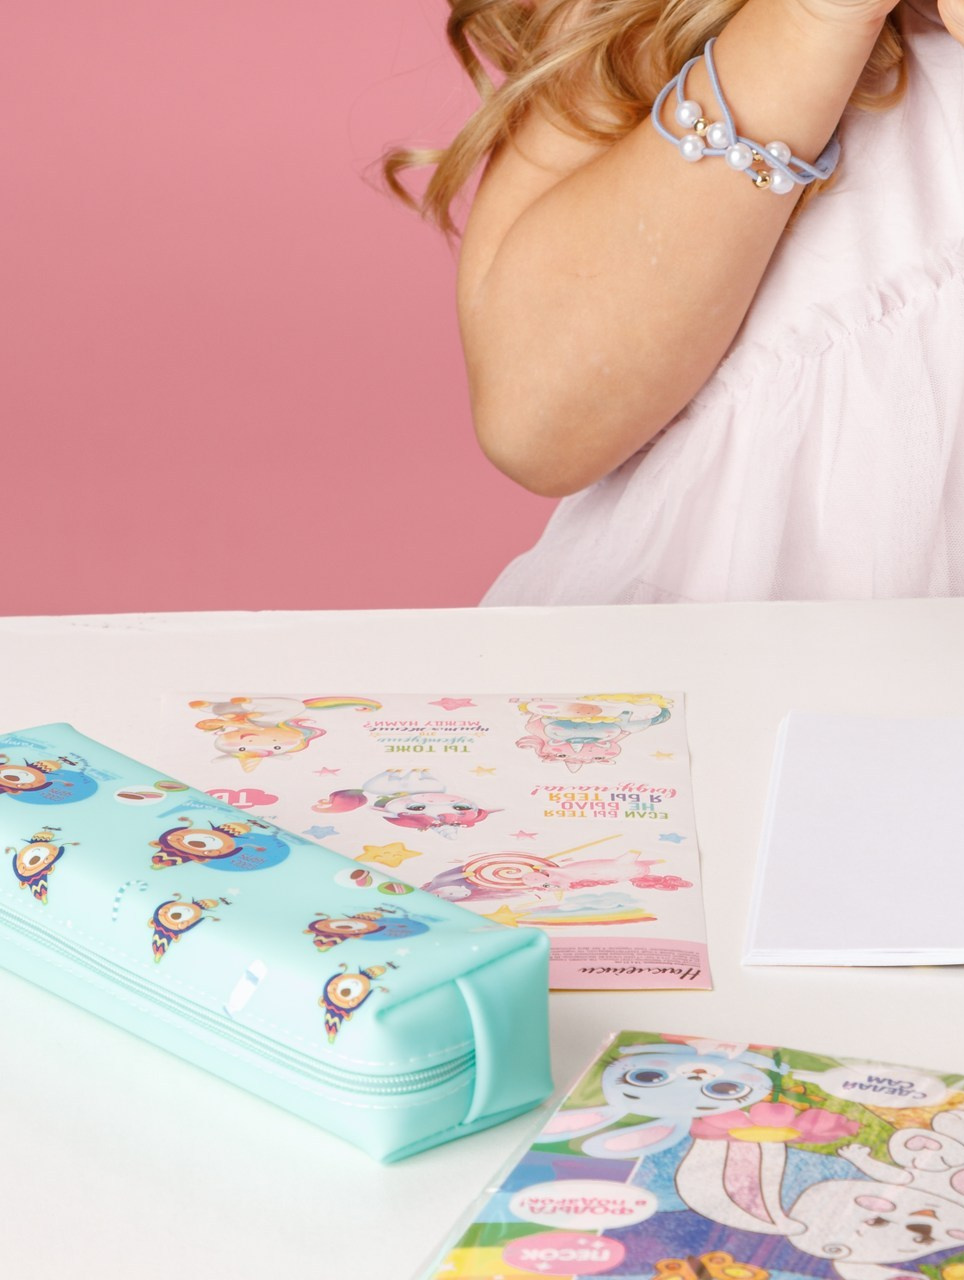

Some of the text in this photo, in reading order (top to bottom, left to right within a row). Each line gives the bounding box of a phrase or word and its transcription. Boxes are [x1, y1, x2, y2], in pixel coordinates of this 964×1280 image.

[363, 720, 418, 728] НАМИ?
[384, 745, 470, 753] ТЫ ТОЖЕ
[549, 792, 662, 804] Я БЫ ТЕБЯ
[556, 800, 655, 811] НЕ БЫЛО,
[543, 809, 669, 820] ЕСЛИ БЫ ТЕБЯ
[578, 966, 702, 981] Наклейки
[866, 1075, 915, 1089] САМ
[842, 1081, 927, 1100] СДЕЛАЙ
[529, 1205, 635, 1217] ФОЛЬГА
[520, 1248, 611, 1262] ПЕСОК
